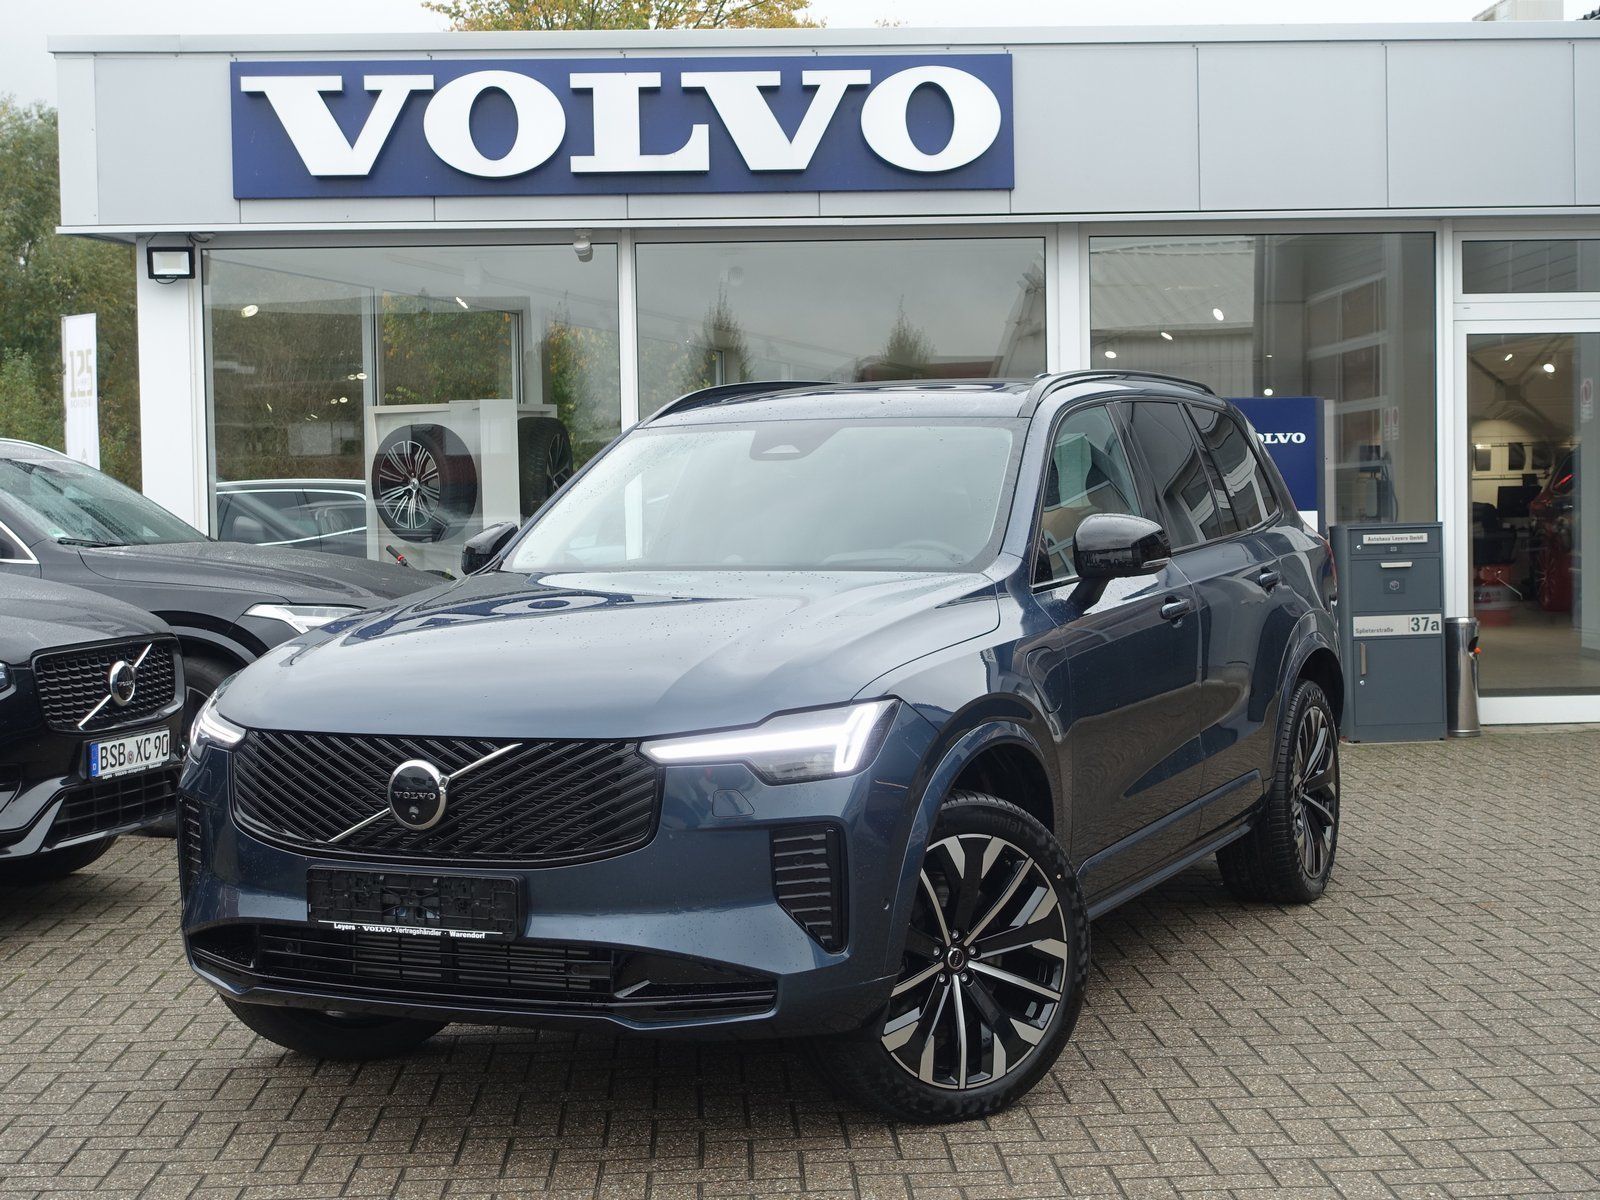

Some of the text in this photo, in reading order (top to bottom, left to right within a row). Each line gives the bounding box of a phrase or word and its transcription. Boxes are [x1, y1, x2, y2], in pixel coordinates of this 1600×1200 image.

[240, 65, 1003, 178] VOLVO
[1355, 616, 1440, 635] Splieterstraße 37a
[100, 742, 126, 770] BSB
[135, 737, 151, 763] XC
[154, 733, 169, 758] 90
[393, 791, 436, 800] VOLVO
[333, 922, 356, 931] Leyers
[449, 930, 486, 939] Warendorf
